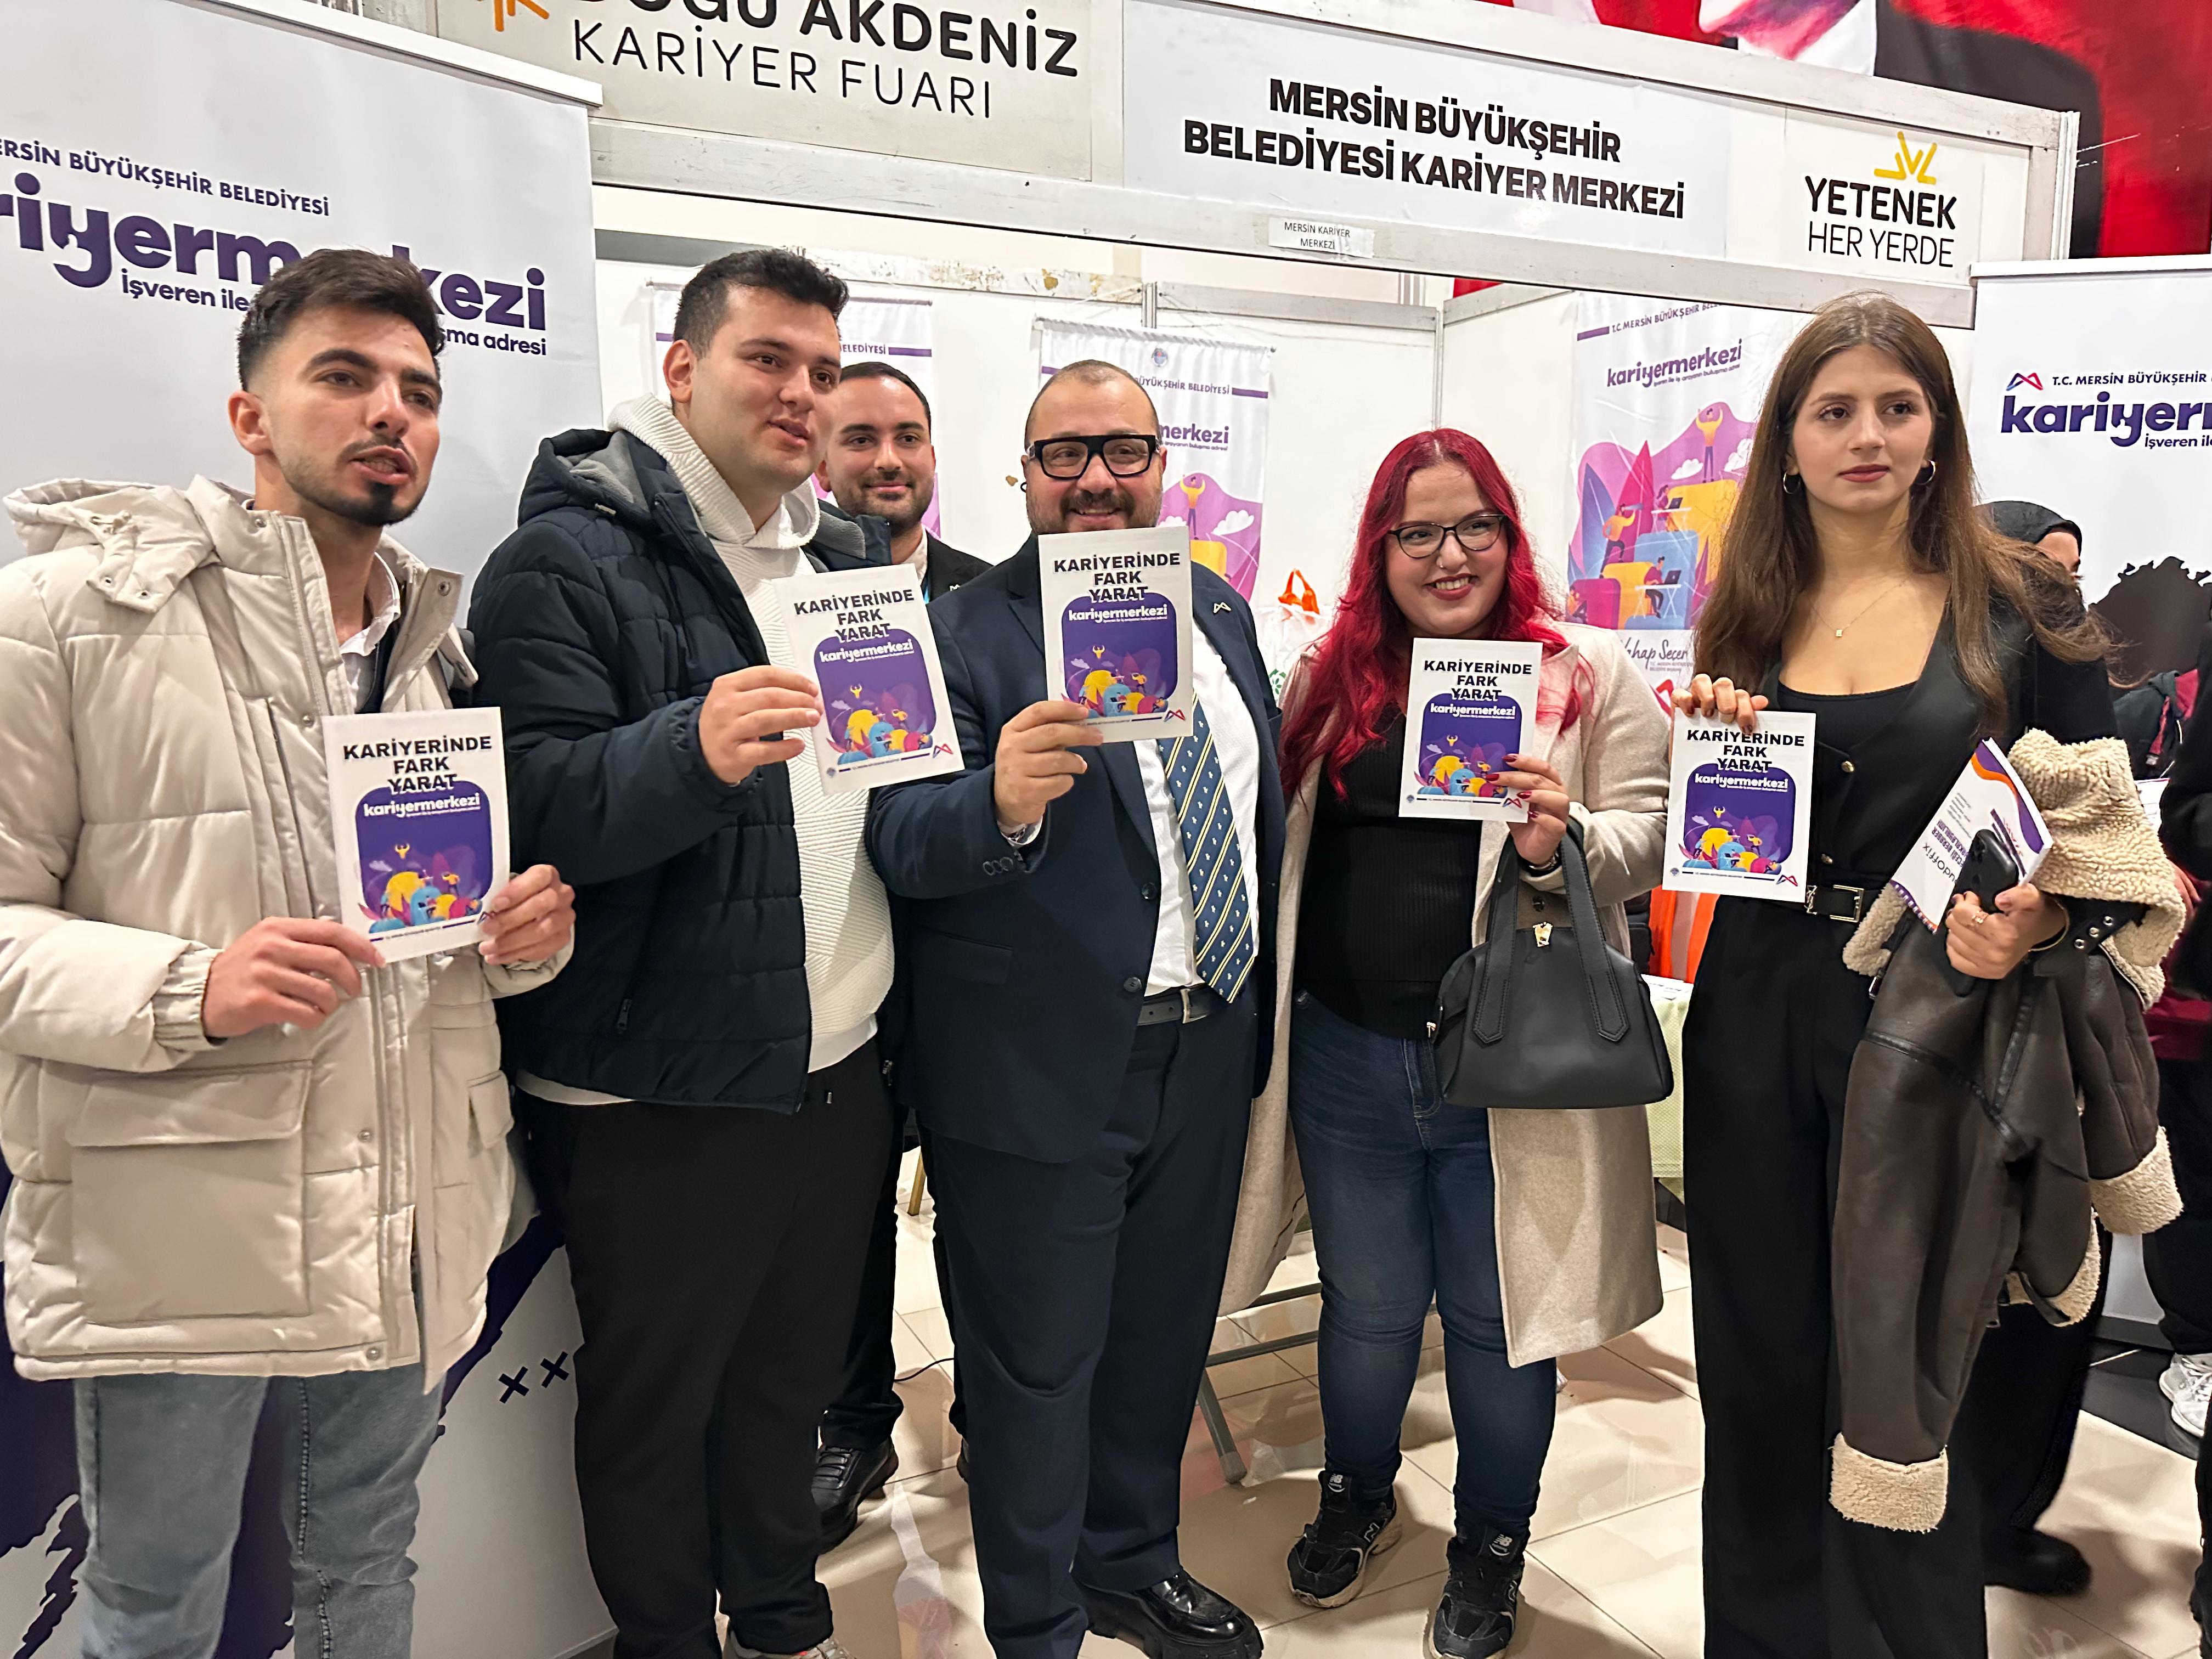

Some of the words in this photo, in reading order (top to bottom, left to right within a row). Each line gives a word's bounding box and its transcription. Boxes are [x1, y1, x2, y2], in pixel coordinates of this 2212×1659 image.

[799, 0, 1078, 77] AKDENİZ
[574, 19, 817, 93] KARİYER
[842, 60, 990, 119] FUARI
[1270, 78, 1408, 131] MERSİN
[1415, 95, 1621, 163] BÜYÜKŞEHİR
[1184, 119, 1395, 180] BELEDİYESİ
[1401, 152, 1547, 200] KARİYER
[1551, 173, 1685, 219] MERKEZİ
[69, 150, 213, 195] BÜYÜKŞEHİR
[219, 180, 329, 216] BELEDİYESİ
[1804, 176, 1957, 230] YETENEK
[1284, 222, 1316, 234] MERSİN
[1318, 225, 1350, 238] KARİYER
[1300, 238, 1335, 250] MERKEZİ
[1808, 221, 1861, 257] HER
[1869, 228, 1954, 268] YERDE
[121, 268, 216, 307] İşveren
[221, 288, 251, 312] ile
[483, 334, 546, 356] adresi
[840, 343, 886, 354] ELEDİYESİ
[1607, 338, 1742, 388] kariyermerkezi
[2052, 376, 2073, 386] T.C.
[2075, 373, 2124, 385] MERSİN
[2128, 371, 2207, 386] BÜYÜKŞEHİR
[1188, 383, 1229, 394] BELEDİYESİ
[2001, 391, 2212, 447] kariyer
[2145, 433, 2198, 450] İşveren
[1054, 552, 1181, 572] KARİYERİNDE
[1094, 571, 1142, 585] FARK
[794, 589, 915, 615] KARİYERİNDE
[1088, 586, 1148, 602] YARAT
[837, 608, 883, 626] FARK
[1069, 604, 1167, 623] kariyermerkezi
[835, 623, 891, 641] YARAT
[819, 639, 913, 663] kariyermerkezi
[1424, 659, 1532, 675] KARİYERİNDE
[1457, 675, 1498, 687] FARK
[1451, 688, 1502, 701] YARAT
[1430, 703, 1516, 717] kariyermerkezi
[1687, 729, 1805, 747] KARİYERİNDE
[343, 735, 492, 760] KARİYERİNDE
[1723, 744, 1768, 758] FARK
[393, 757, 449, 774] FARK
[1717, 758, 1772, 772] YARAT
[388, 774, 457, 793] YARAT
[1695, 773, 1788, 789] kariyermerkezi
[363, 793, 480, 817] kariyermerkezi
